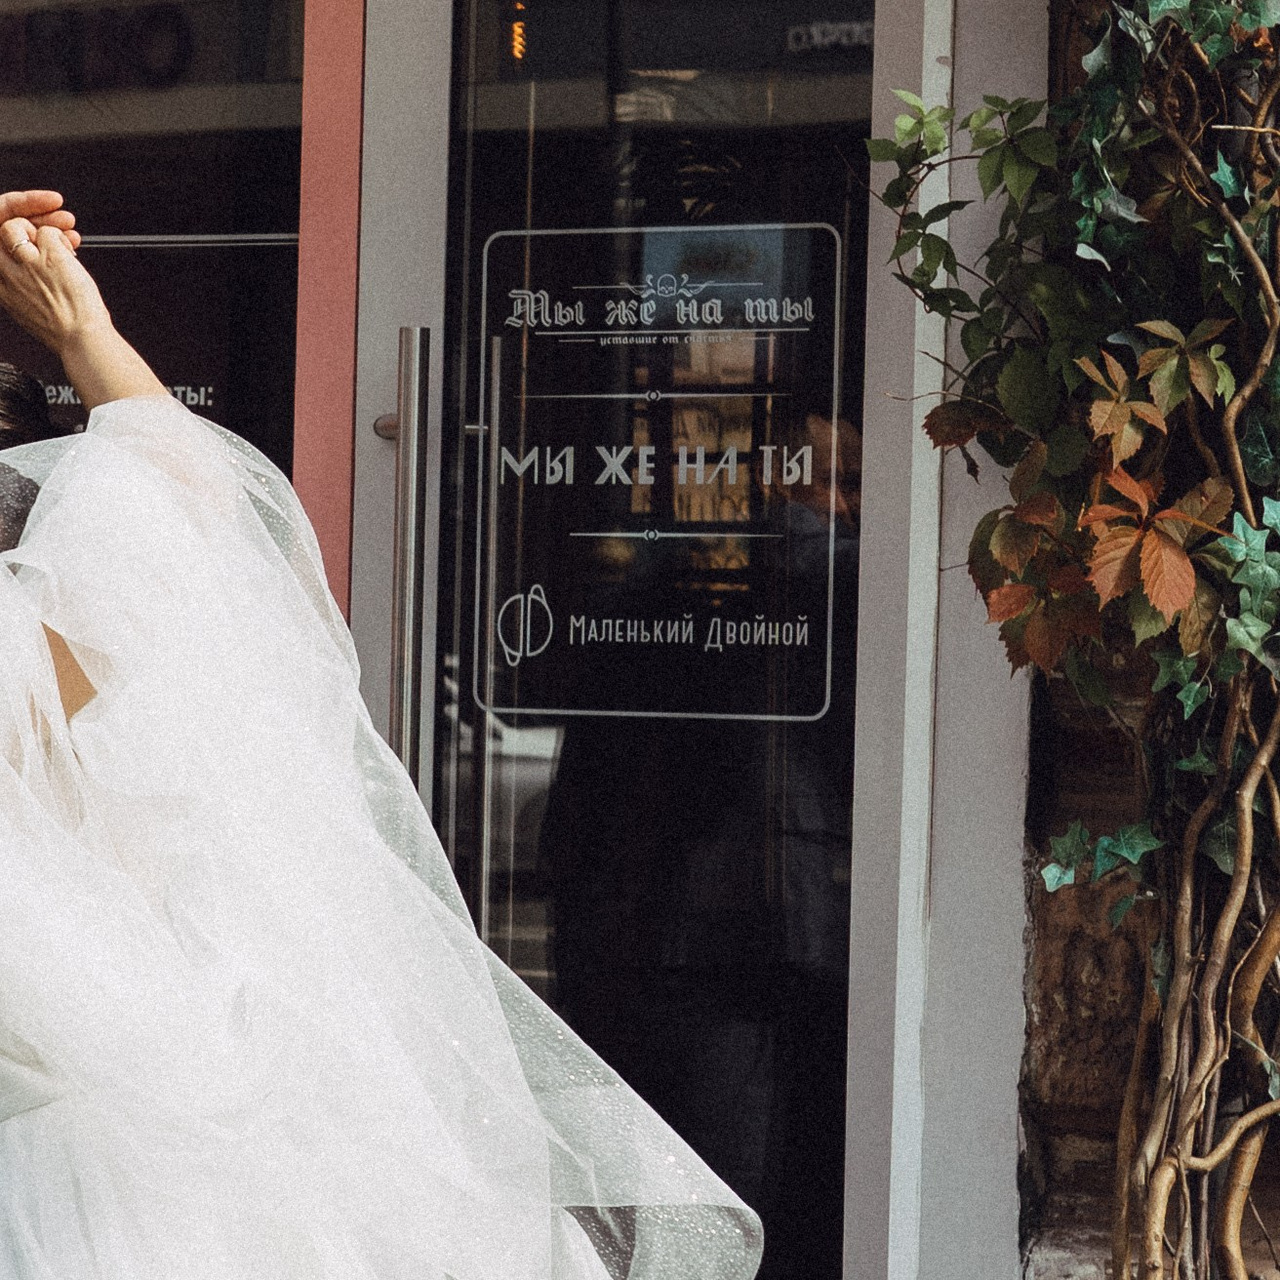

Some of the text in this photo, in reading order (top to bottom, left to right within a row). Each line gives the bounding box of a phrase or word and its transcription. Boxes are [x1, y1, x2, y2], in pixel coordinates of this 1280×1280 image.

[505, 289, 586, 328] Мы
[605, 298, 657, 327] же
[675, 298, 725, 326] на
[500, 446, 813, 486] МЫ ЖЕ НА ТЫ
